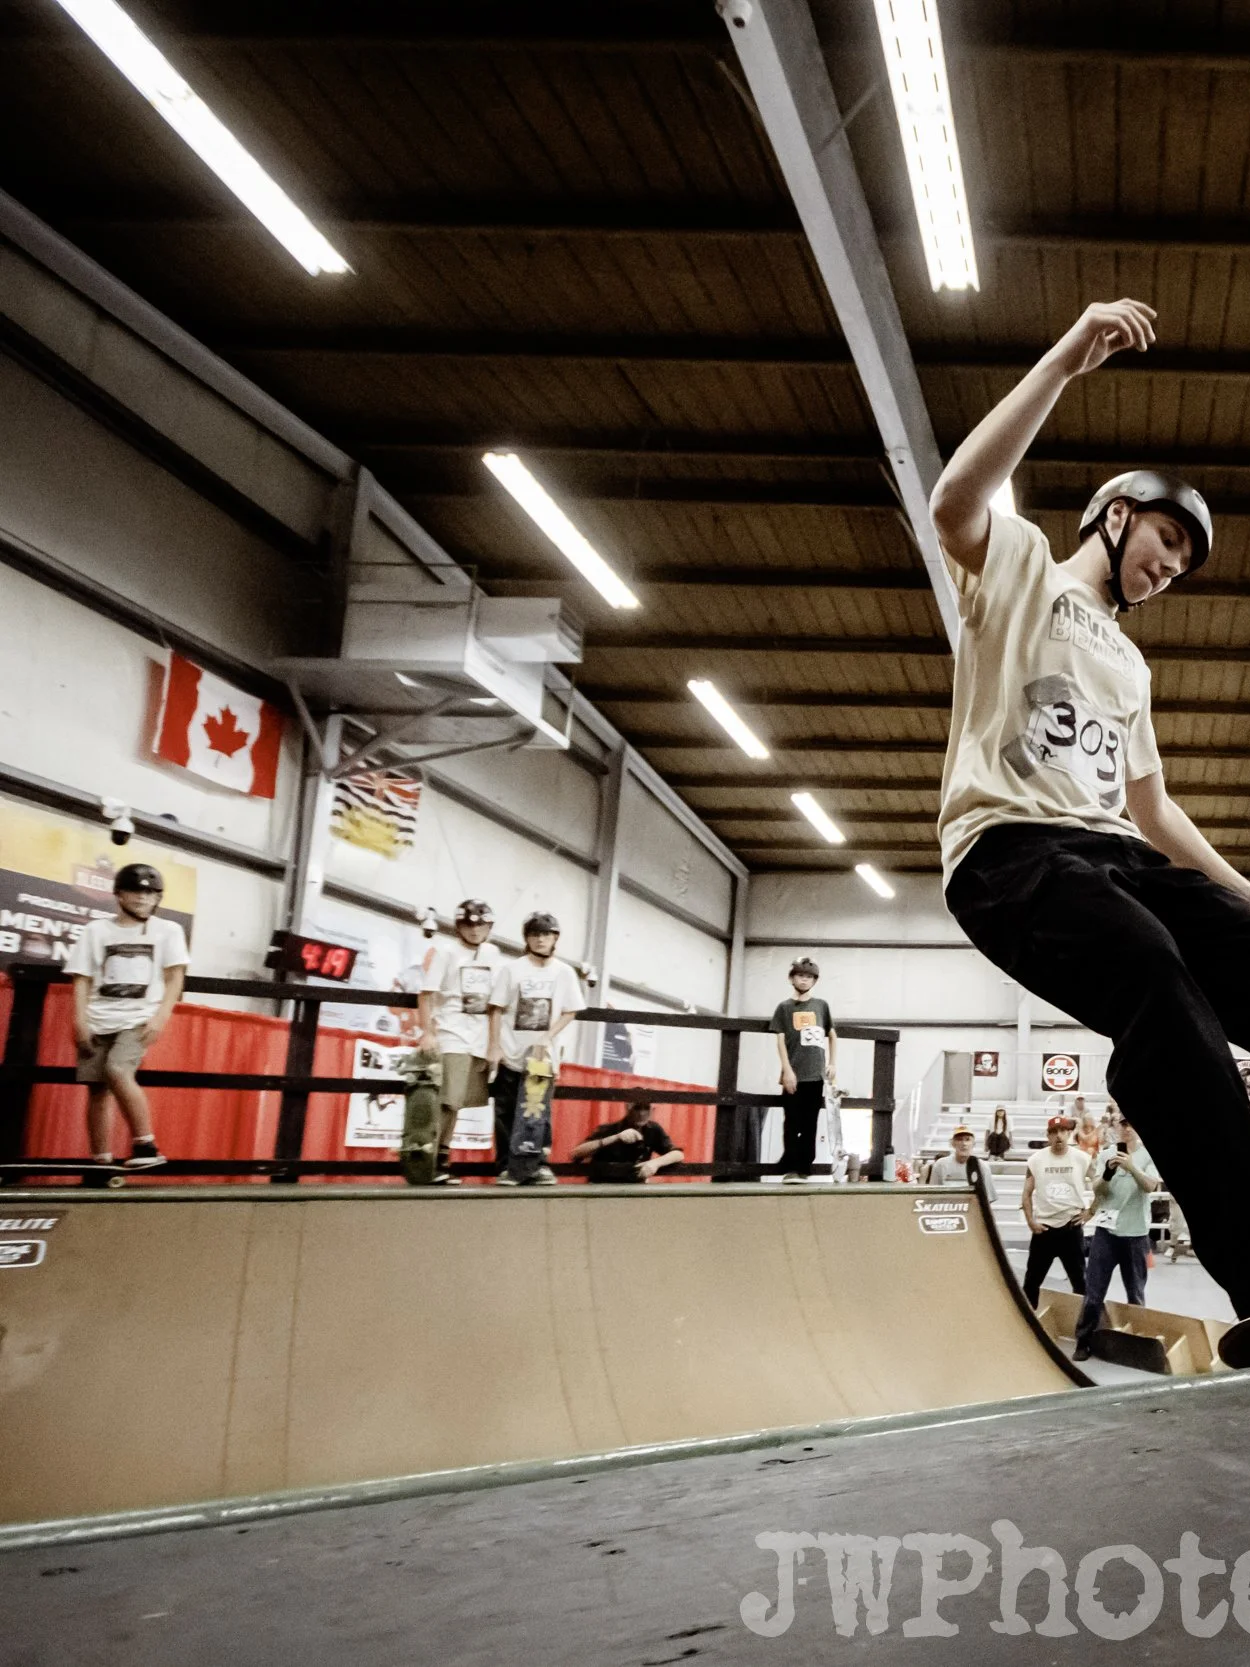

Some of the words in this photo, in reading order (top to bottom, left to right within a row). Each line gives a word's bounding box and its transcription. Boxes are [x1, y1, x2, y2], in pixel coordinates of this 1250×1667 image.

[1044, 701, 1119, 782] 303
[1046, 1067, 1074, 1076] BONES
[913, 1199, 969, 1212] SKATELITE
